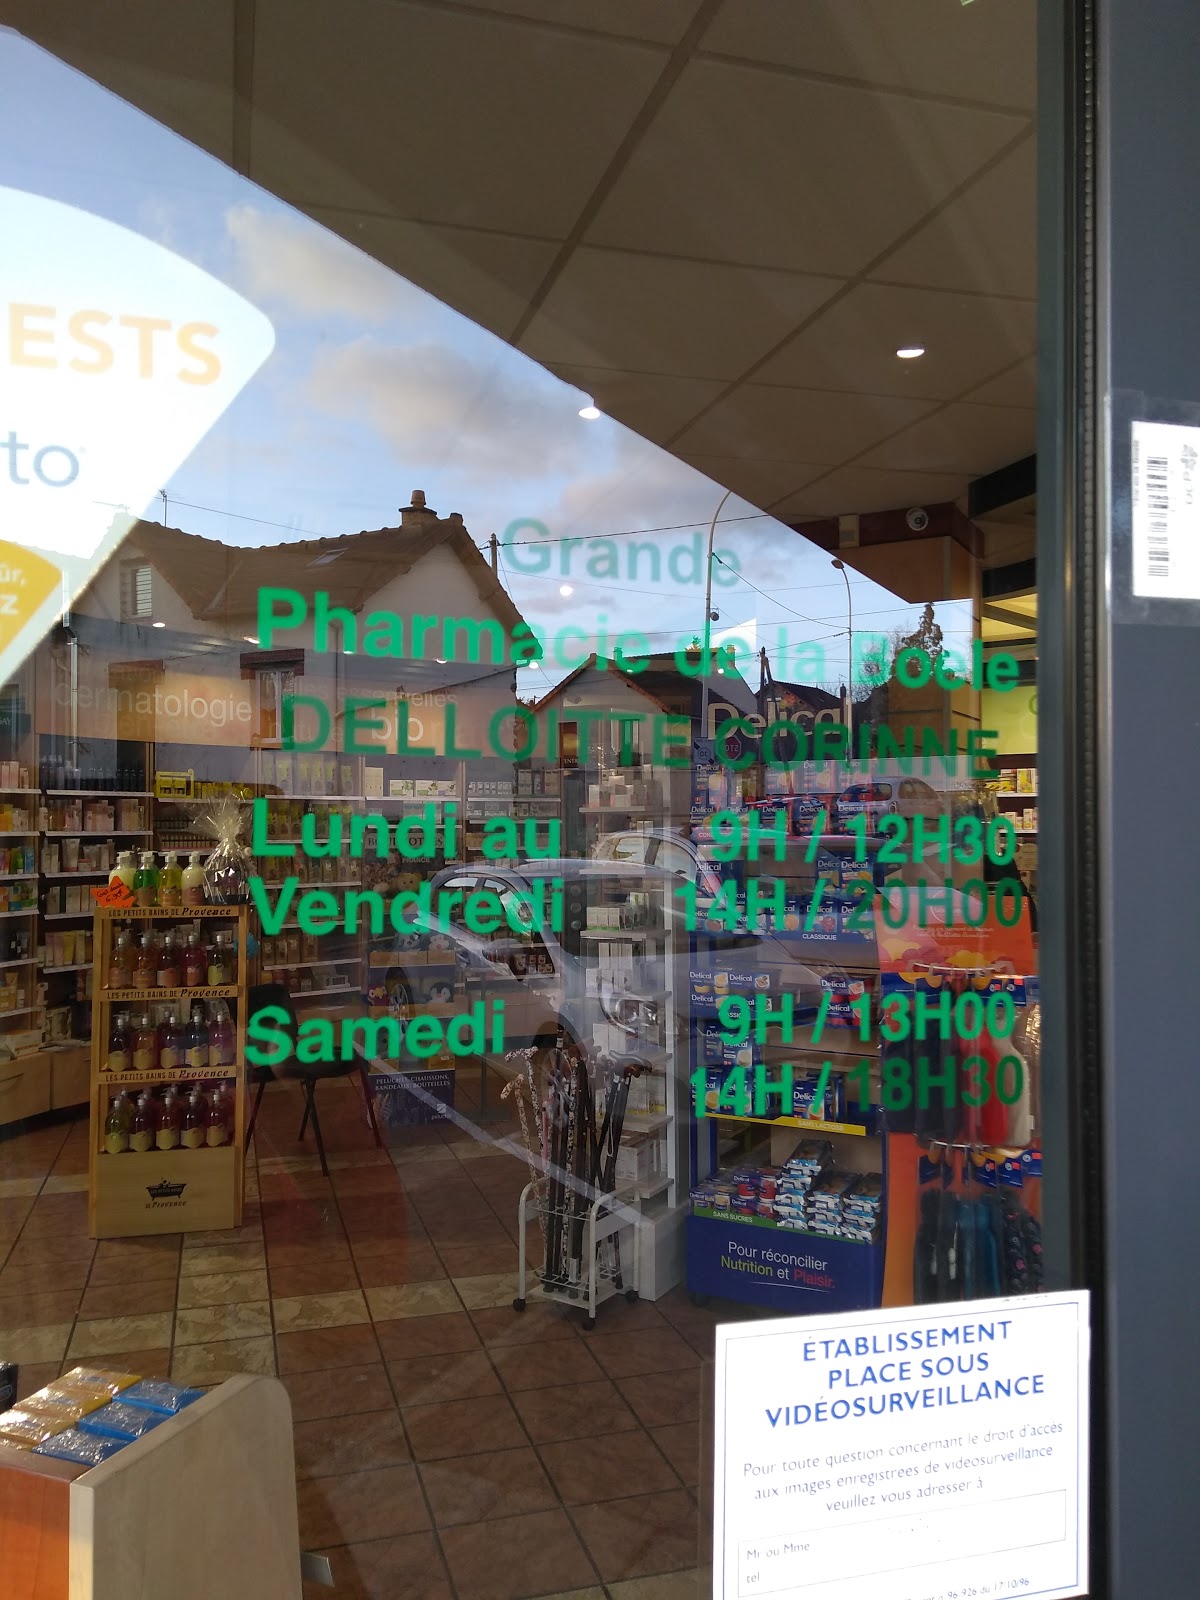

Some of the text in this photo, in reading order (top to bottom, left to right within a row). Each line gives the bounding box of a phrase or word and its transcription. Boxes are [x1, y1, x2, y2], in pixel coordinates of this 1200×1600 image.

[502, 516, 741, 588] Grande
[256, 586, 650, 674] Pharmacie
[674, 620, 751, 680] de
[777, 626, 826, 682] la
[281, 695, 689, 768] DELLOITTE
[715, 717, 999, 778] CORINNE
[252, 798, 560, 860] Lundi au
[710, 810, 1016, 866] 9H / 12H30
[123, 909, 146, 917] PETITS
[148, 908, 169, 916] BAINS
[171, 908, 179, 916] DE
[182, 907, 231, 916] Provence
[247, 876, 562, 936] Vendredi
[675, 877, 1022, 932] 14H / 20H00
[802, 933, 837, 941] CLASSIQUE
[107, 988, 230, 1000] LES PETITS BAINS DE Provence
[244, 1000, 504, 1066] Samedi
[719, 991, 1017, 1044] 9H / 13H00
[105, 1069, 229, 1082] LES PETITS BAINS DE Provence
[689, 1056, 1023, 1118] 14H / 18H30
[797, 1120, 815, 1128] SANS
[712, 1210, 753, 1223] SANS SUCRES
[721, 1255, 835, 1289] Nutrition et Plaisir.
[728, 1241, 828, 1271] Pour réconcilier
[803, 1320, 1012, 1362] ÉTABLISSEMENT
[828, 1352, 990, 1390] PLACE SOUS
[765, 1374, 1045, 1428] VIDÉOSURVEILLANCE
[743, 1421, 1063, 1478] Pour toute question concernant le droit d'accès
[754, 1487, 779, 1500] aux
[785, 1479, 831, 1496] images
[924, 1460, 940, 1474] de
[826, 1493, 876, 1512] veuillez
[881, 1489, 912, 1503] vous
[916, 1480, 973, 1498] adresser
[766, 1548, 780, 1558] ou
[783, 1542, 810, 1554] Mme
